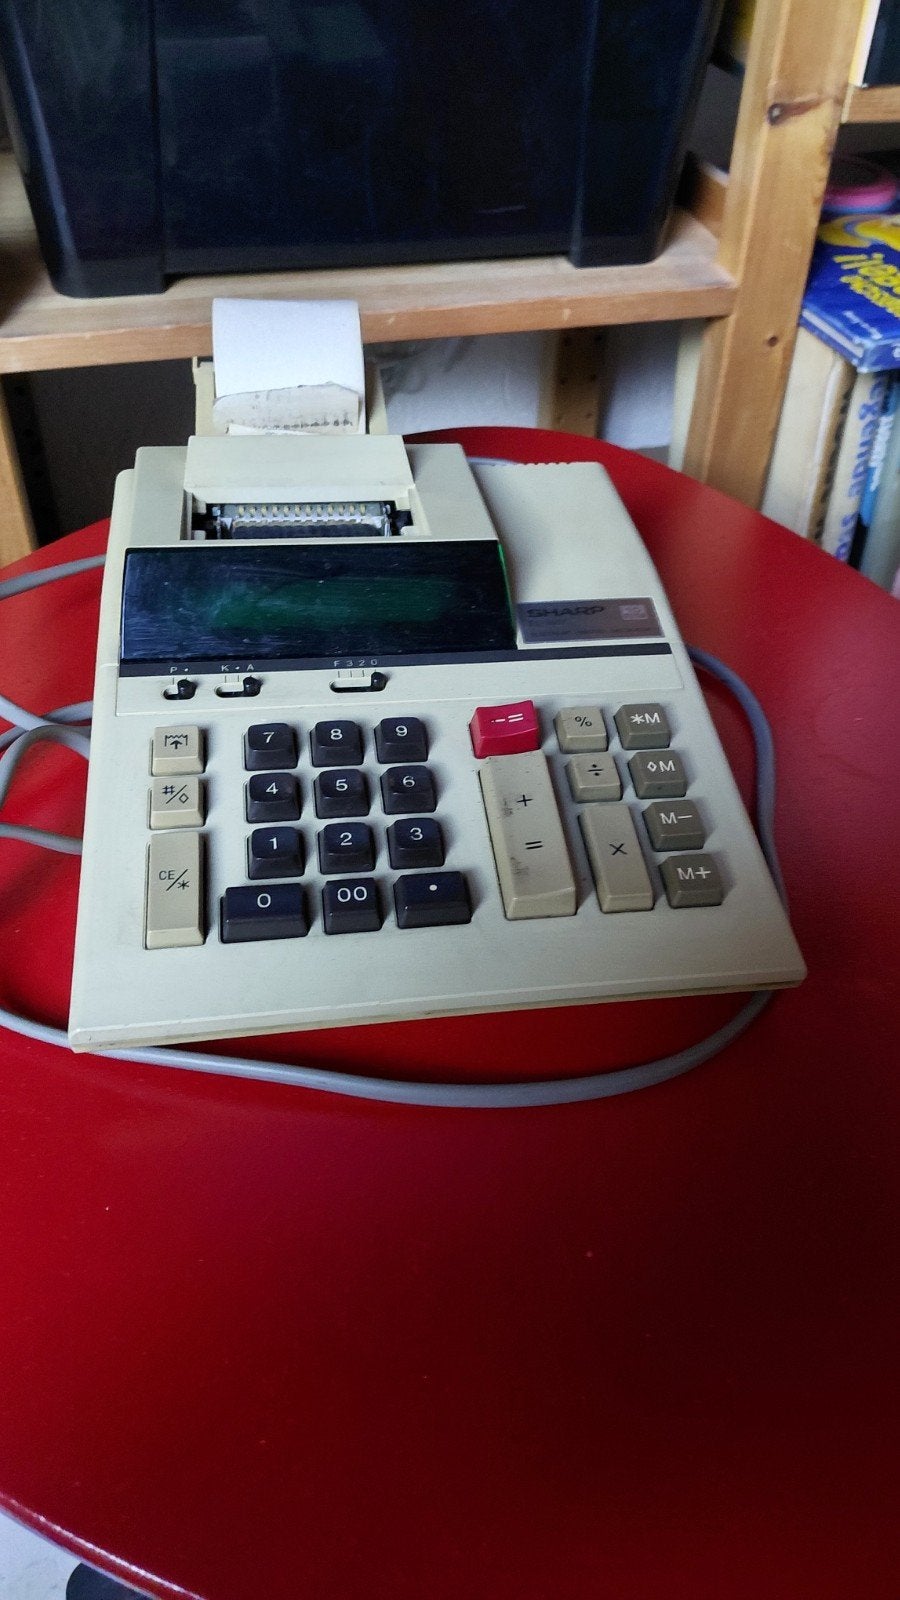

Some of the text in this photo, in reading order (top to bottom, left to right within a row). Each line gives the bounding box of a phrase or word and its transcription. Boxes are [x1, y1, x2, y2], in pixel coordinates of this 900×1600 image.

[526, 605, 605, 618] SHARP
[573, 714, 593, 728] %
[262, 731, 275, 744] 7
[330, 728, 343, 741] 8
[395, 724, 408, 738] 9
[265, 782, 279, 795] 4
[335, 778, 348, 792] 5
[402, 775, 416, 788] 6
[339, 832, 353, 846] 2
[409, 827, 423, 841] 3
[269, 837, 278, 850] 1
[676, 866, 711, 880] M+
[256, 893, 272, 908] 0
[336, 885, 368, 903] 00
